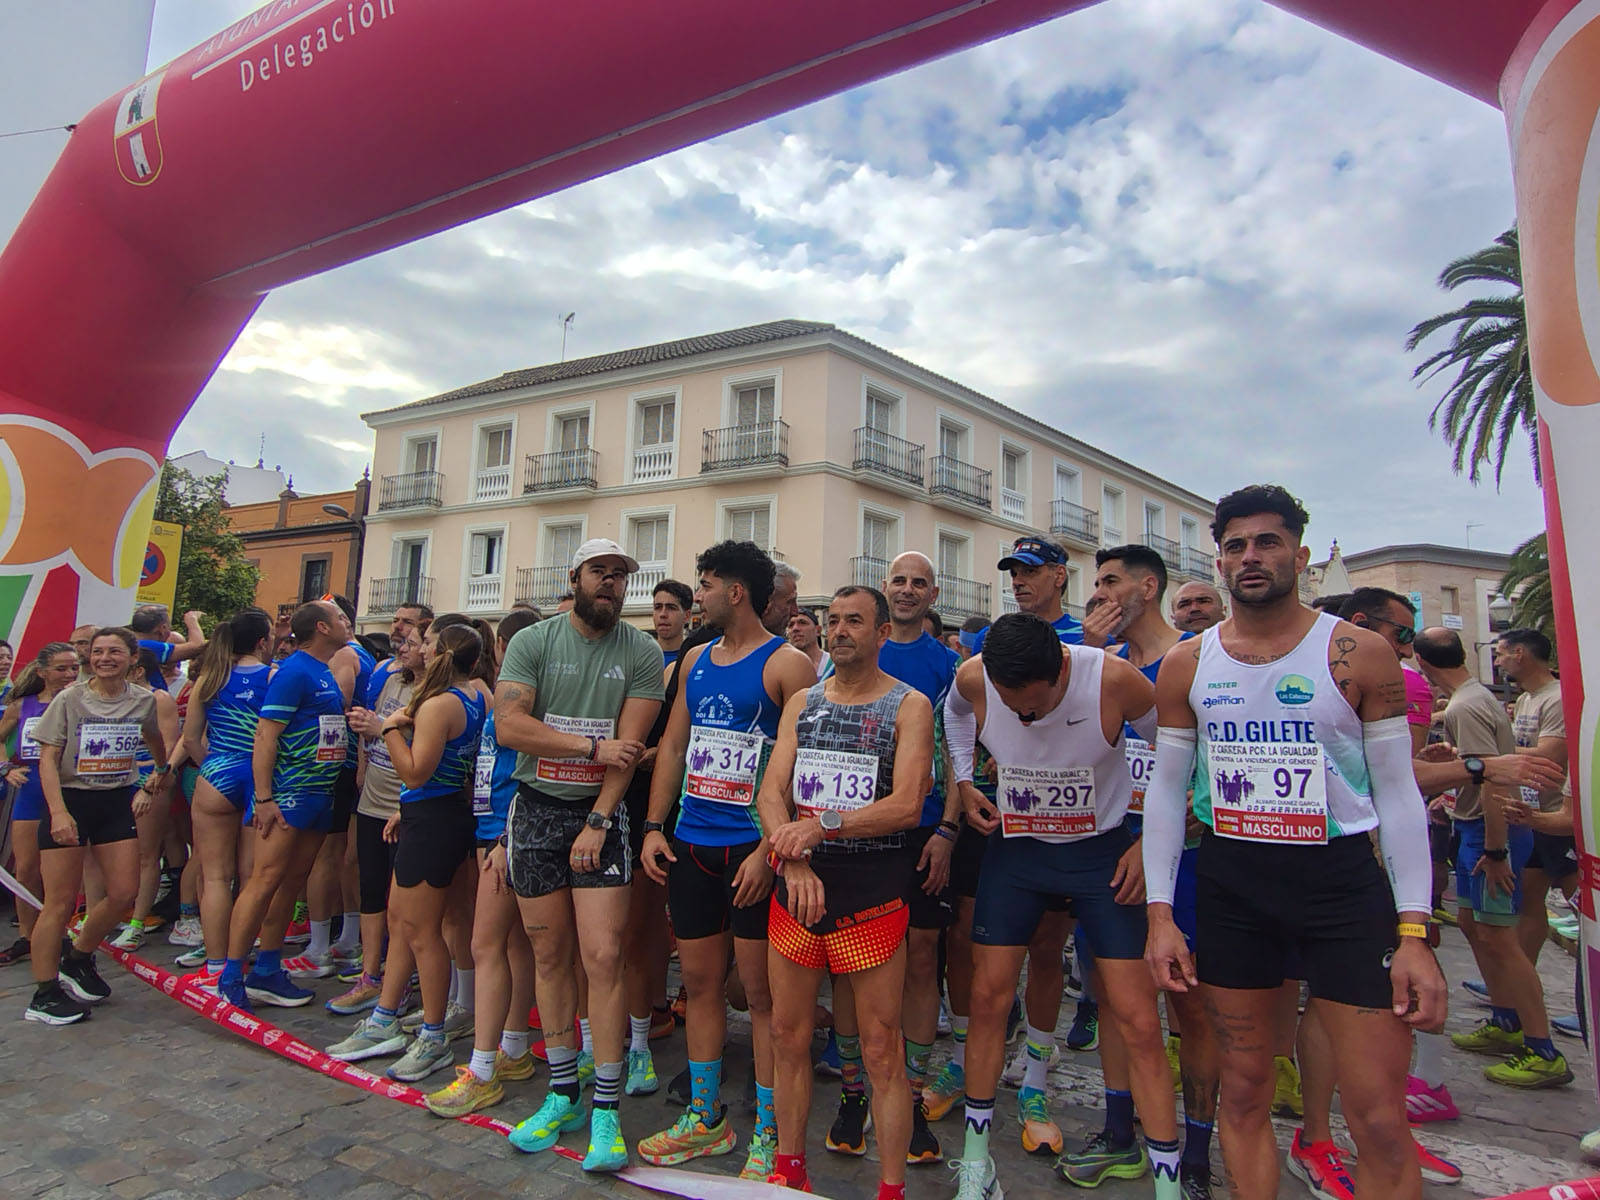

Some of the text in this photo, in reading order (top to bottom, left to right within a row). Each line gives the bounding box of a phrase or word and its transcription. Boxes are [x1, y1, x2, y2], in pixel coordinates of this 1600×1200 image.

[240, 0, 395, 92] Delegación
[1208, 681, 1237, 689] FASTER
[115, 736, 139, 752] 569
[1210, 745, 1318, 757] X CARRERA POR LA IGUALDAD
[720, 747, 757, 774] 314
[1126, 757, 1155, 781] 05
[832, 772, 874, 801] 133
[1273, 767, 1312, 799] 97
[1047, 785, 1093, 807] 297
[1243, 814, 1285, 823] INDIVIDUAL
[1242, 822, 1323, 838] MASCULINO
